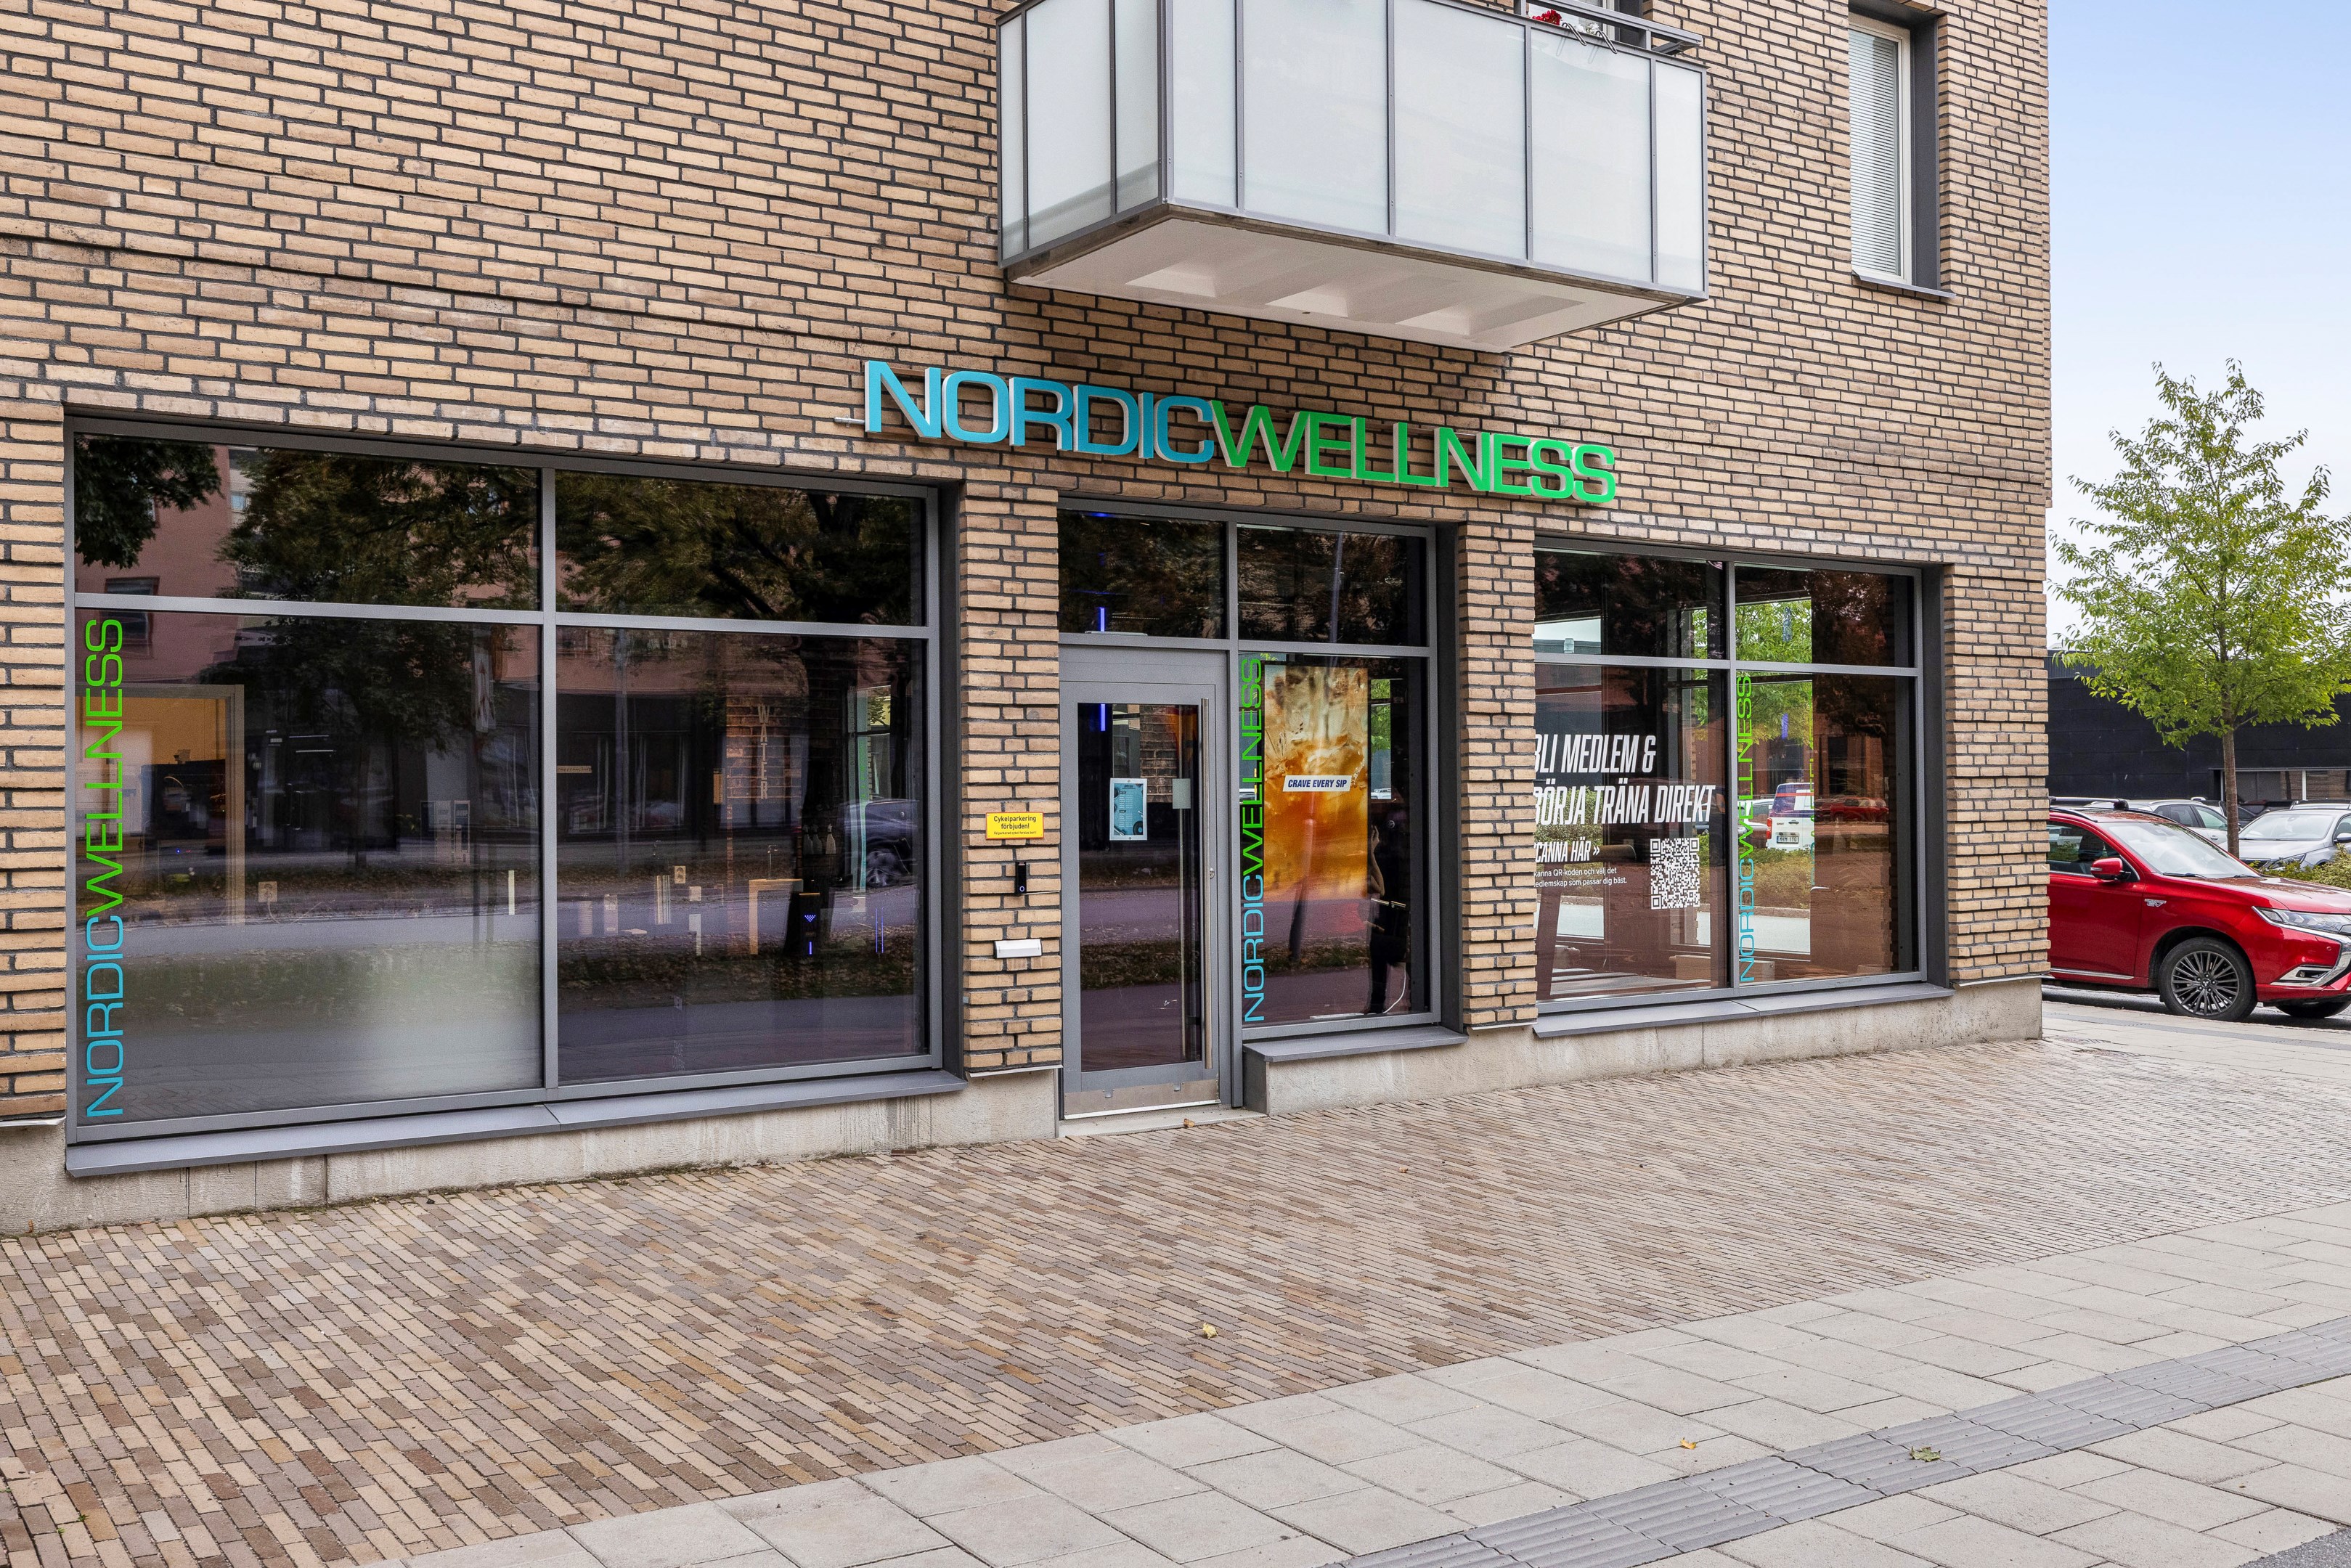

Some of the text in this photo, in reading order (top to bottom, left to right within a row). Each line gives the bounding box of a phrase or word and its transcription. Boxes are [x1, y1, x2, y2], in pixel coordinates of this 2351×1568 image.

[757, 703, 770, 799] WATER
[1561, 734, 1639, 773] MEDLEM
[1642, 735, 1656, 773] &
[1288, 779, 1347, 788] CRAVE EVERY SIP
[1593, 777, 1650, 825] TRÄNA
[1654, 785, 1716, 823] DIREKT
[1570, 836, 1592, 862] HÄR
